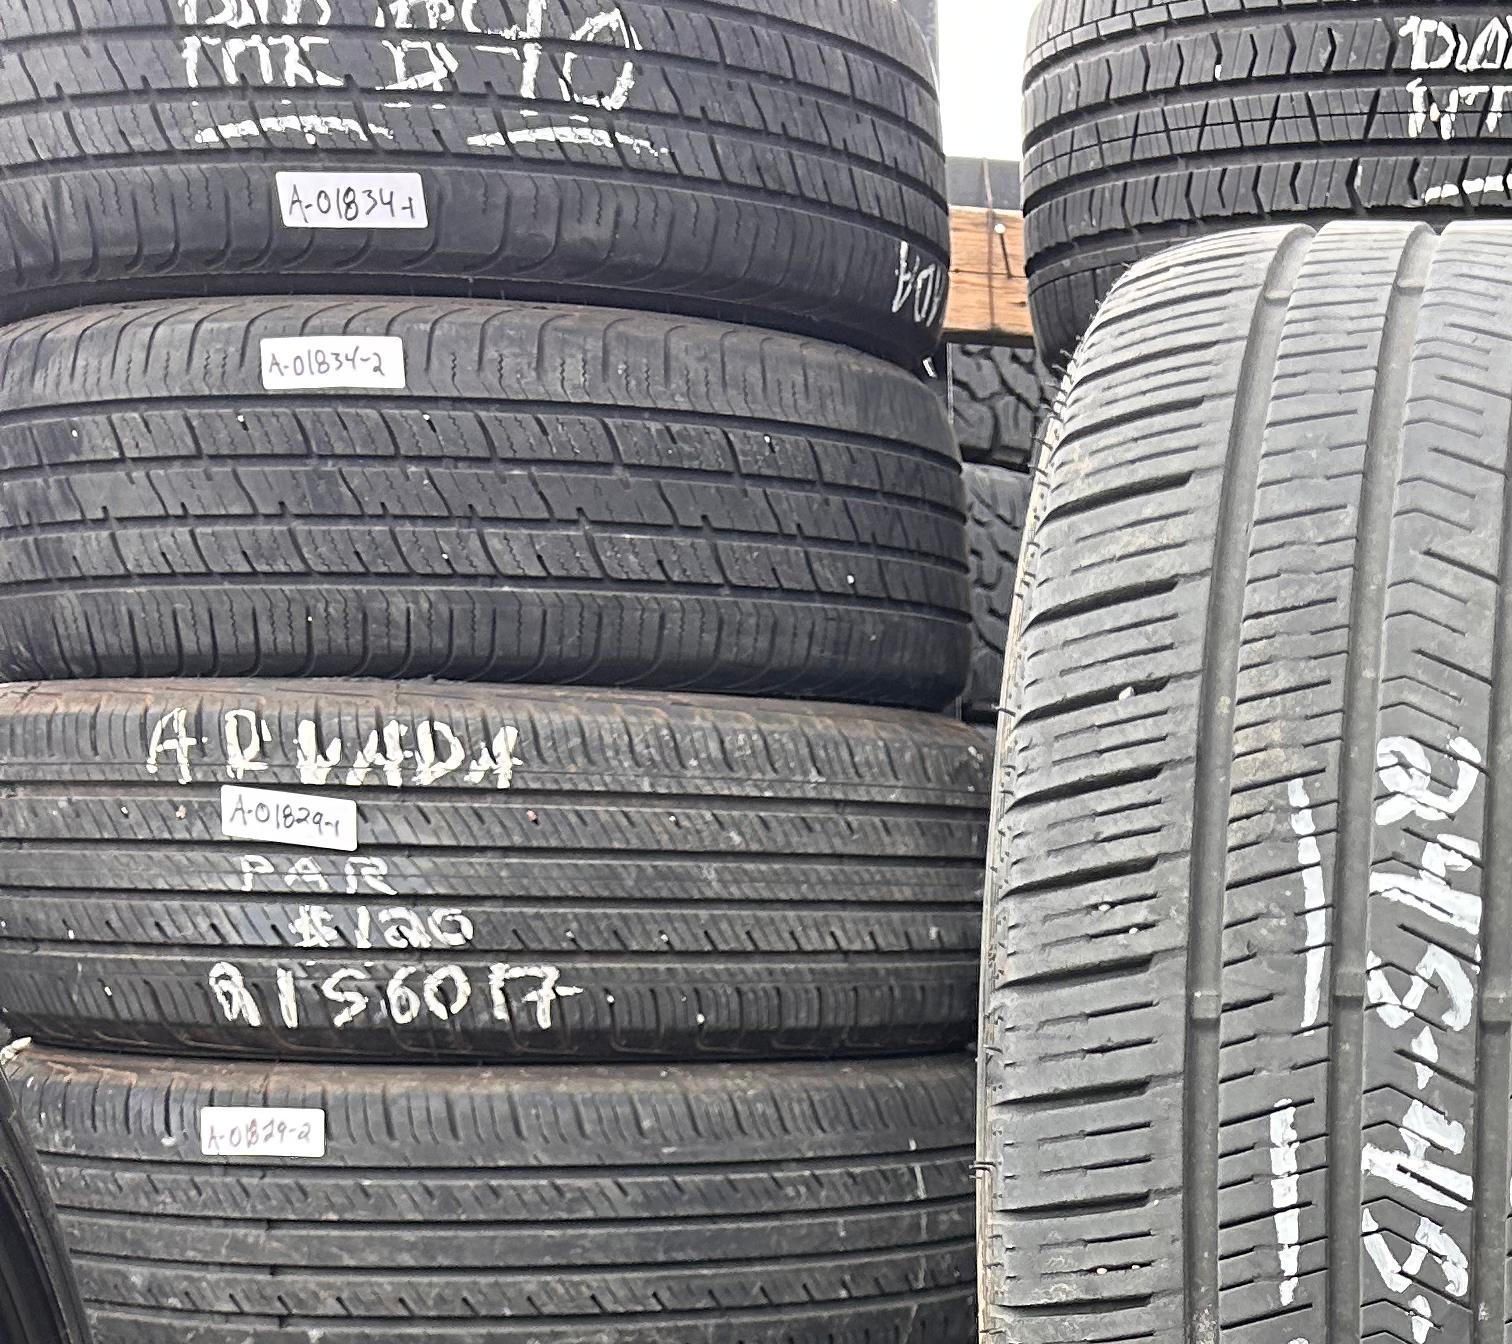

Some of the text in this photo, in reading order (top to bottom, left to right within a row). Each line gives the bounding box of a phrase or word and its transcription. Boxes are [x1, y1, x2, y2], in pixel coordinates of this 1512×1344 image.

[288, 183, 416, 223] A-01834-1
[268, 346, 387, 376] A-01834-2
[229, 794, 340, 836] A-01829-1
[240, 854, 398, 895] PAR
[288, 904, 474, 949] $120
